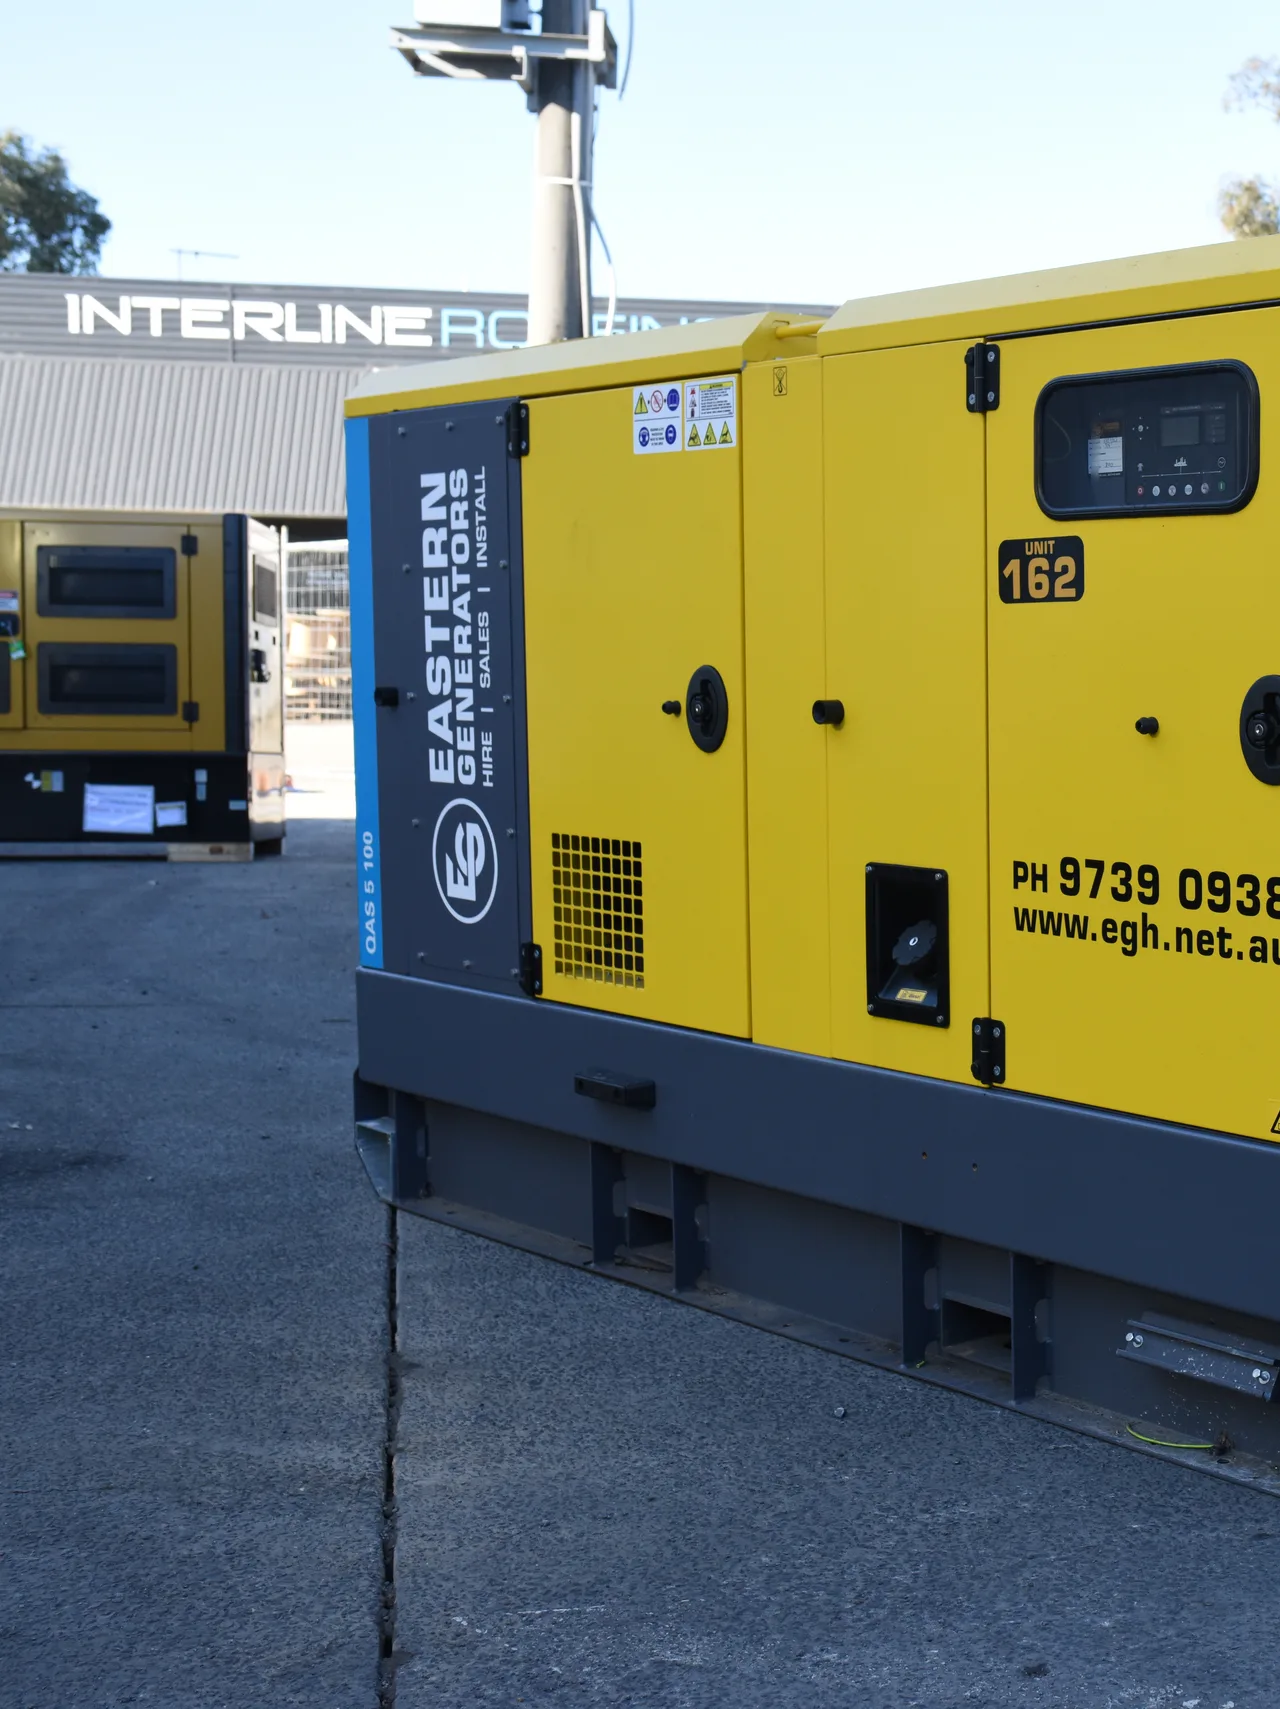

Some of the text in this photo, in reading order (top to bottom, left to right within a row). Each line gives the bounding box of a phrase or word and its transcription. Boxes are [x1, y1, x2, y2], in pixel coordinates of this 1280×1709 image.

[64, 293, 433, 347] INTERLINE
[1002, 556, 1076, 600] 162
[1025, 540, 1055, 556] UNIT
[420, 472, 455, 784] EASTERN
[449, 468, 476, 785] GENERATORS
[474, 465, 494, 787] HIRE SALES INSTALL
[362, 831, 377, 955] QAS 5 100
[1013, 860, 1048, 893] PH
[1059, 856, 1160, 905] 9739
